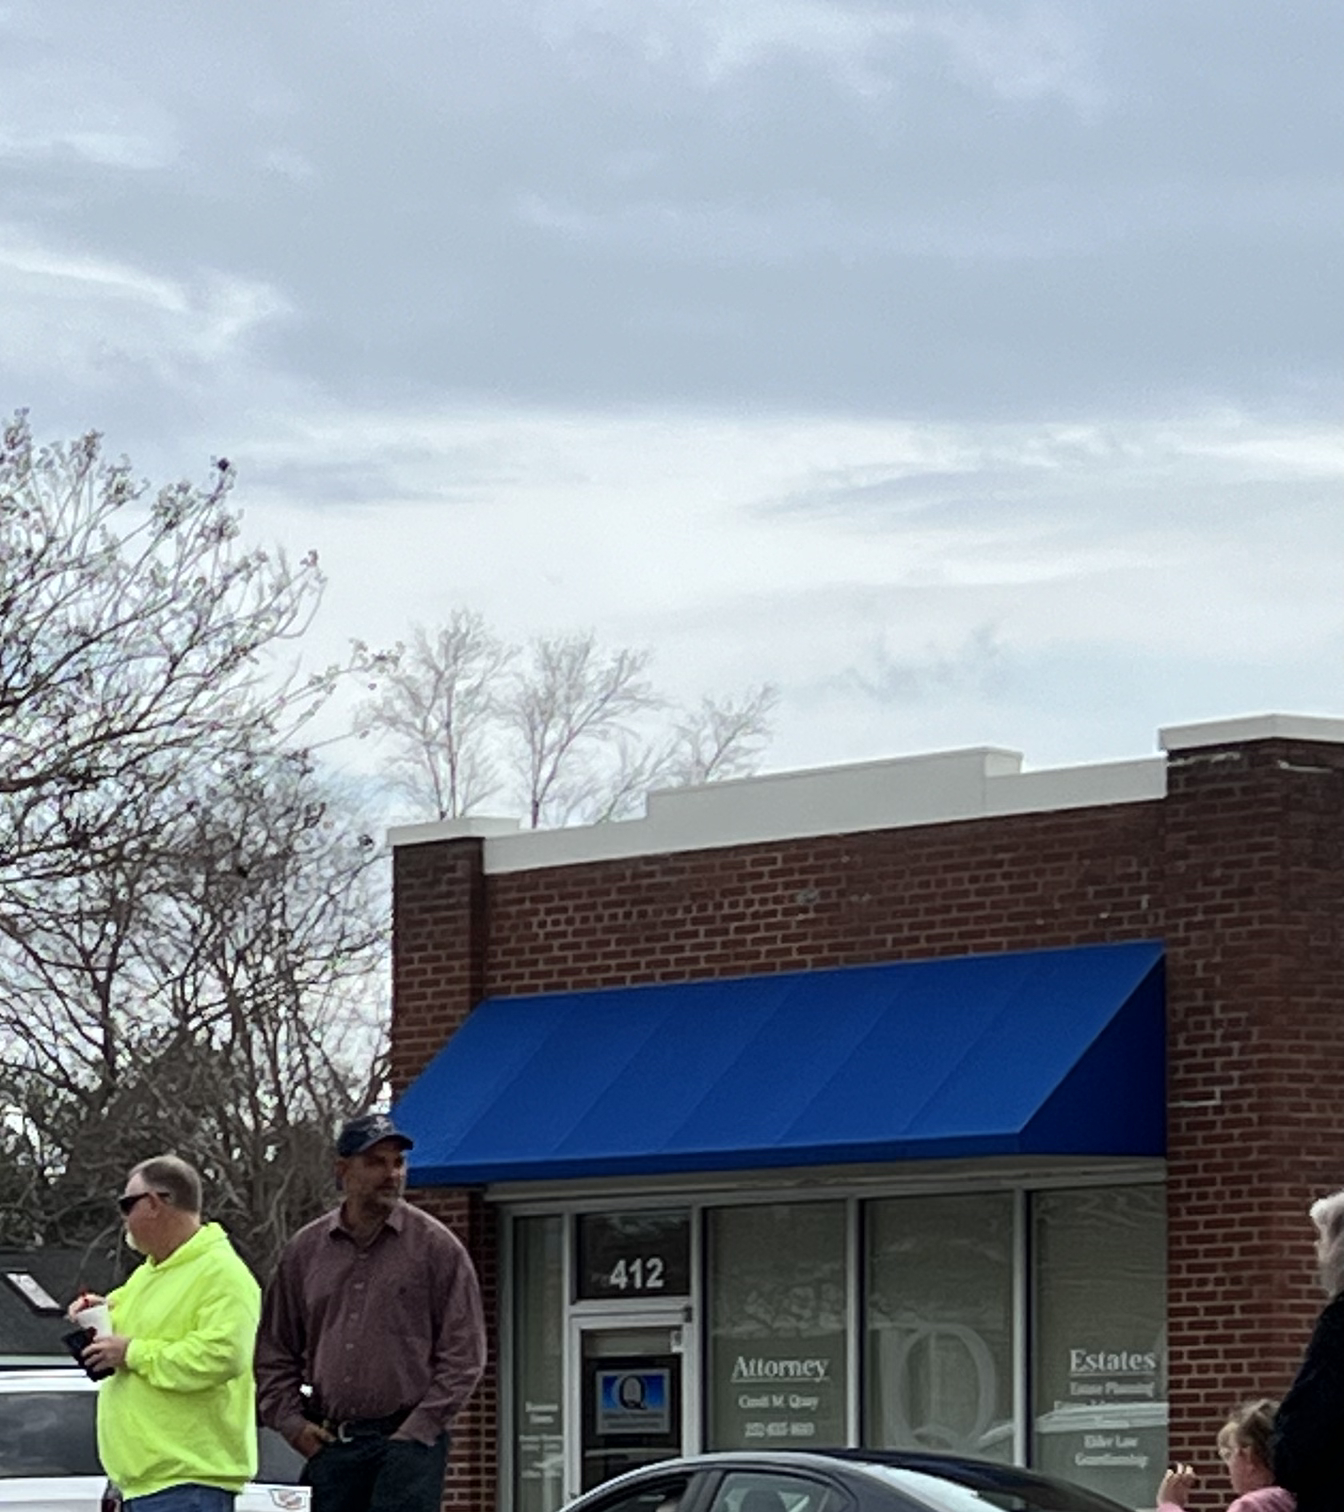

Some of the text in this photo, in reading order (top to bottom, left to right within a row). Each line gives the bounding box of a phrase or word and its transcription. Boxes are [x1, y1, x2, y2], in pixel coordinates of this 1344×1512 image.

[609, 1257, 665, 1290] 412
[732, 1356, 830, 1383] Attorney
[1070, 1349, 1157, 1373] Estates
[619, 1375, 647, 1410] Q
